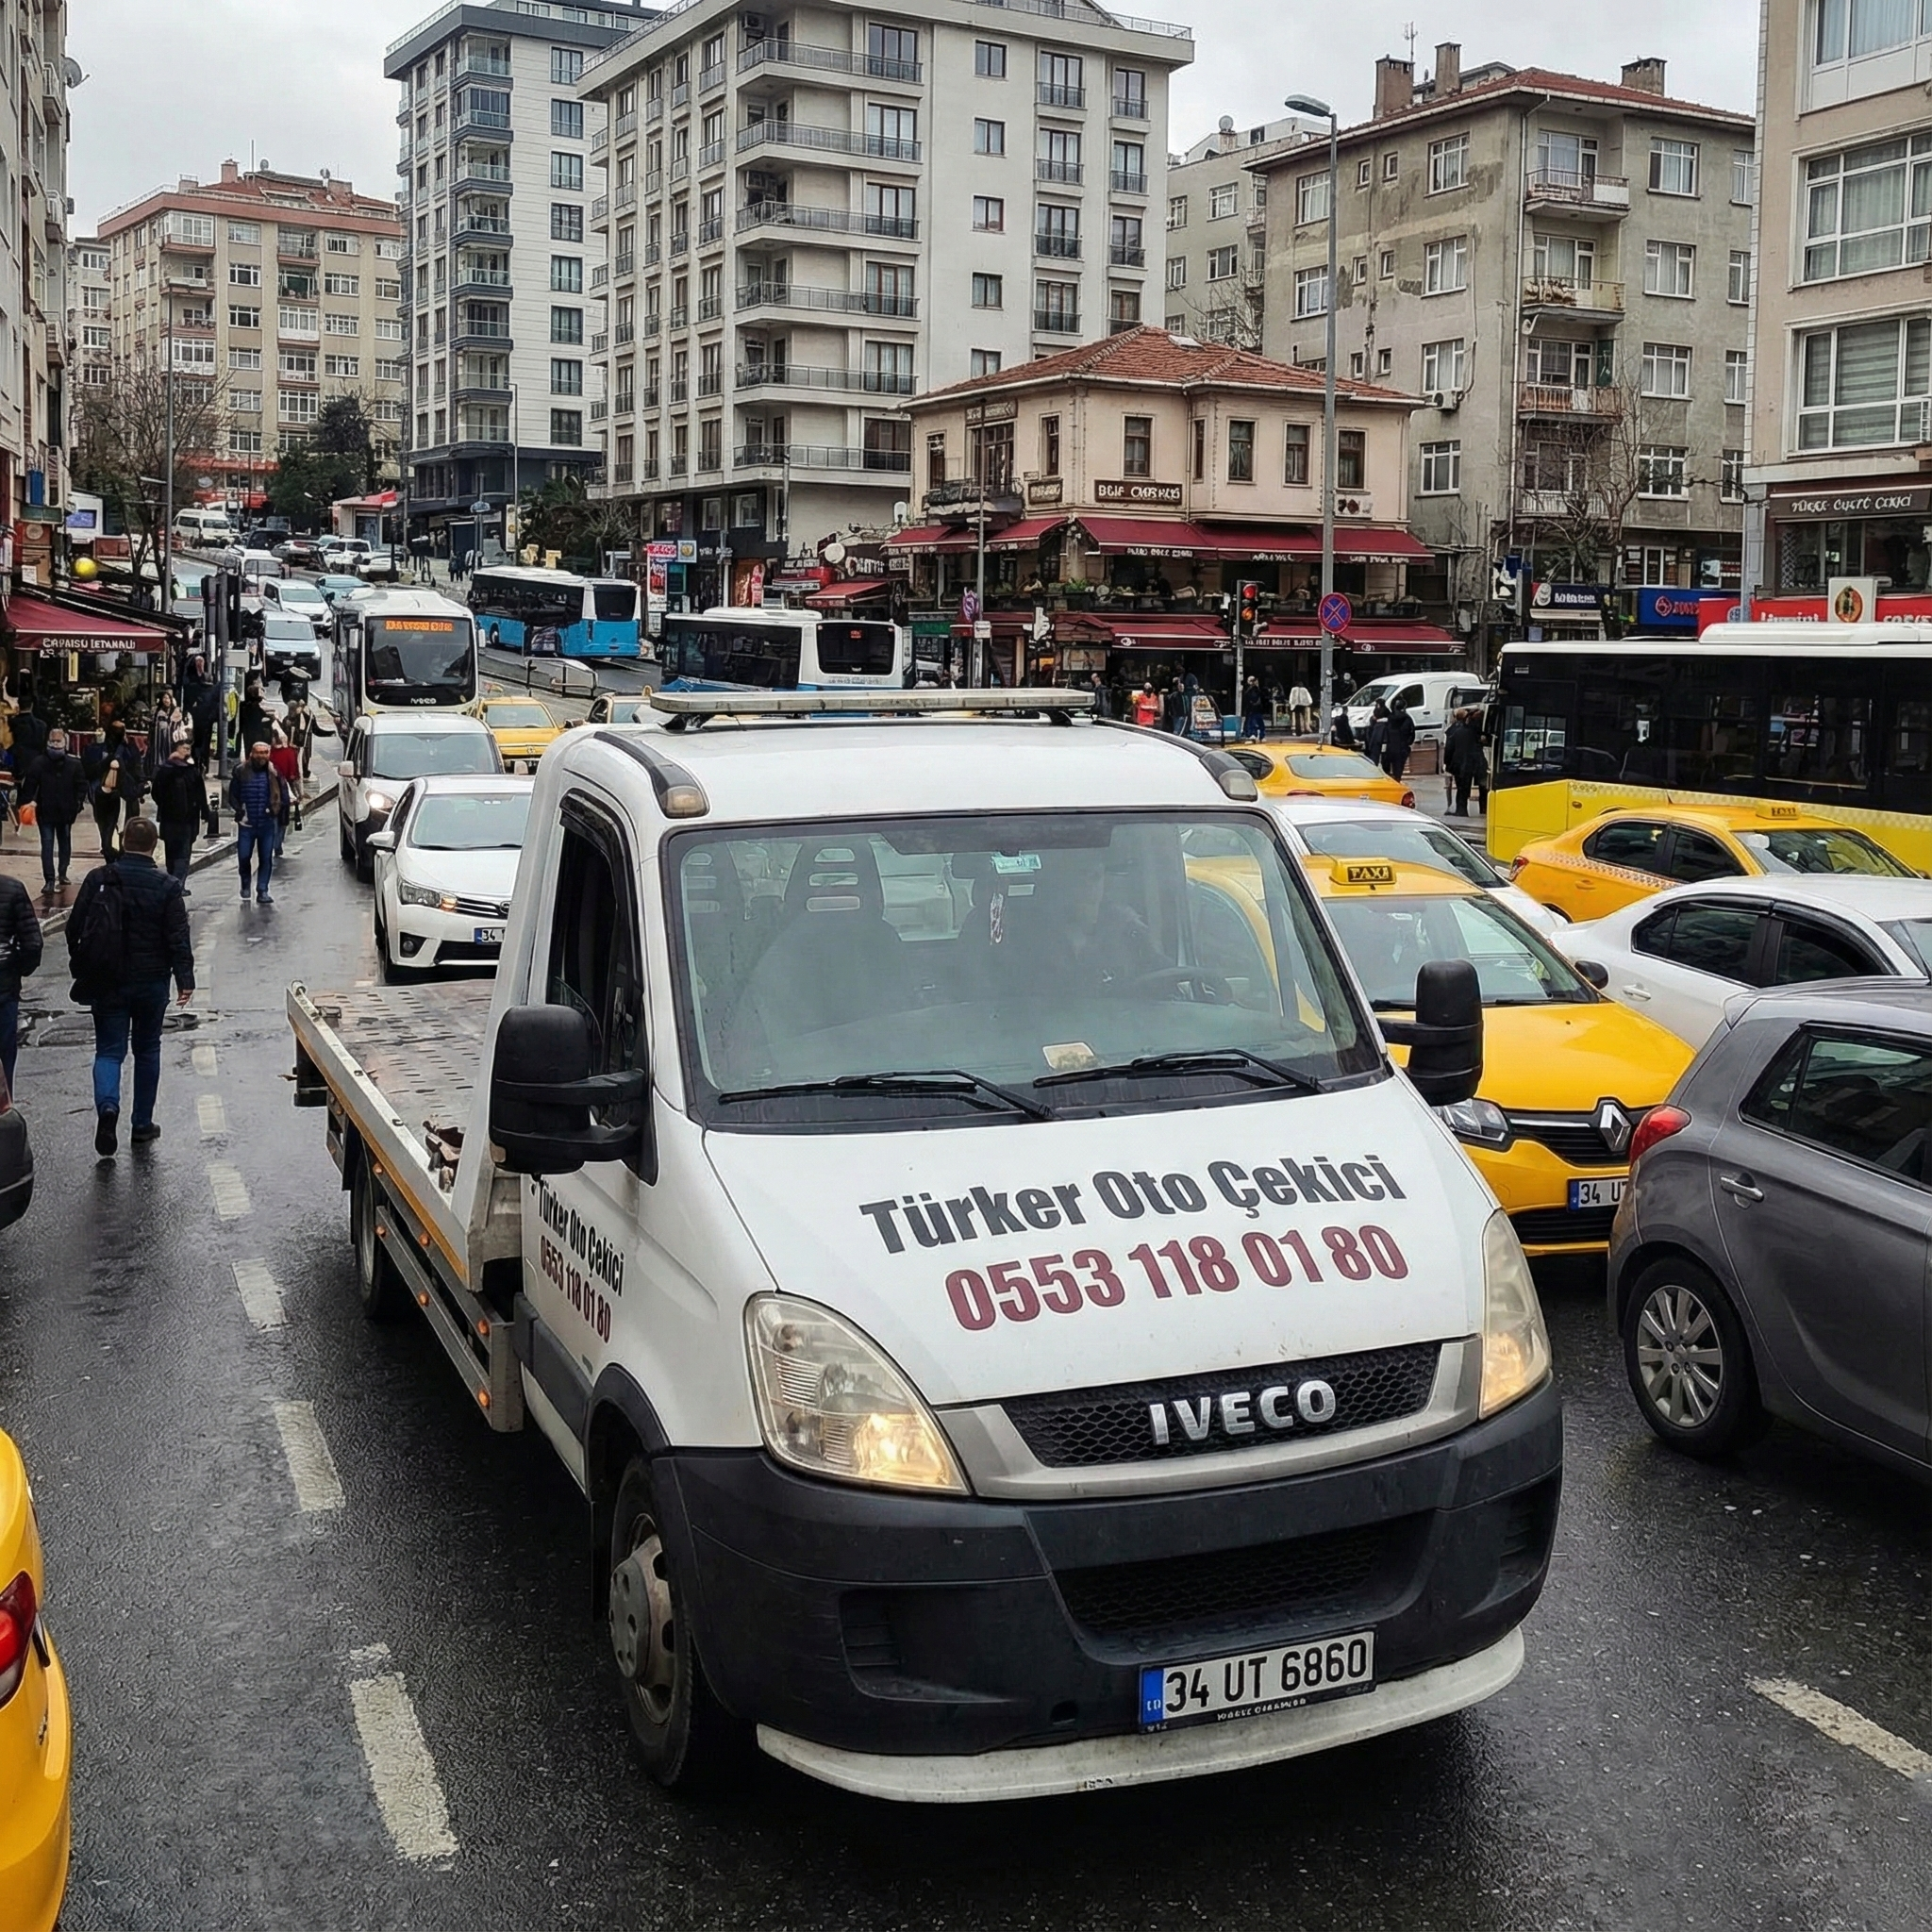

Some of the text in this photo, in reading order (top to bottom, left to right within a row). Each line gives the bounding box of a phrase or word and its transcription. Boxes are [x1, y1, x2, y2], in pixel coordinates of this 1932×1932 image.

[1349, 866, 1390, 881] TAXI
[858, 1154, 1407, 1254] Türker Oto Çekici
[1580, 1182, 1601, 1205] 34
[538, 1179, 625, 1297] Türker Oto Çekici
[945, 1224, 1409, 1331] 0553 118 01 80
[541, 1235, 611, 1343] 0553 118 01 80
[1149, 1379, 1336, 1445] IVECO
[1165, 1667, 1209, 1712] 34
[1224, 1656, 1268, 1702] UT
[1281, 1639, 1367, 1692] 6860
